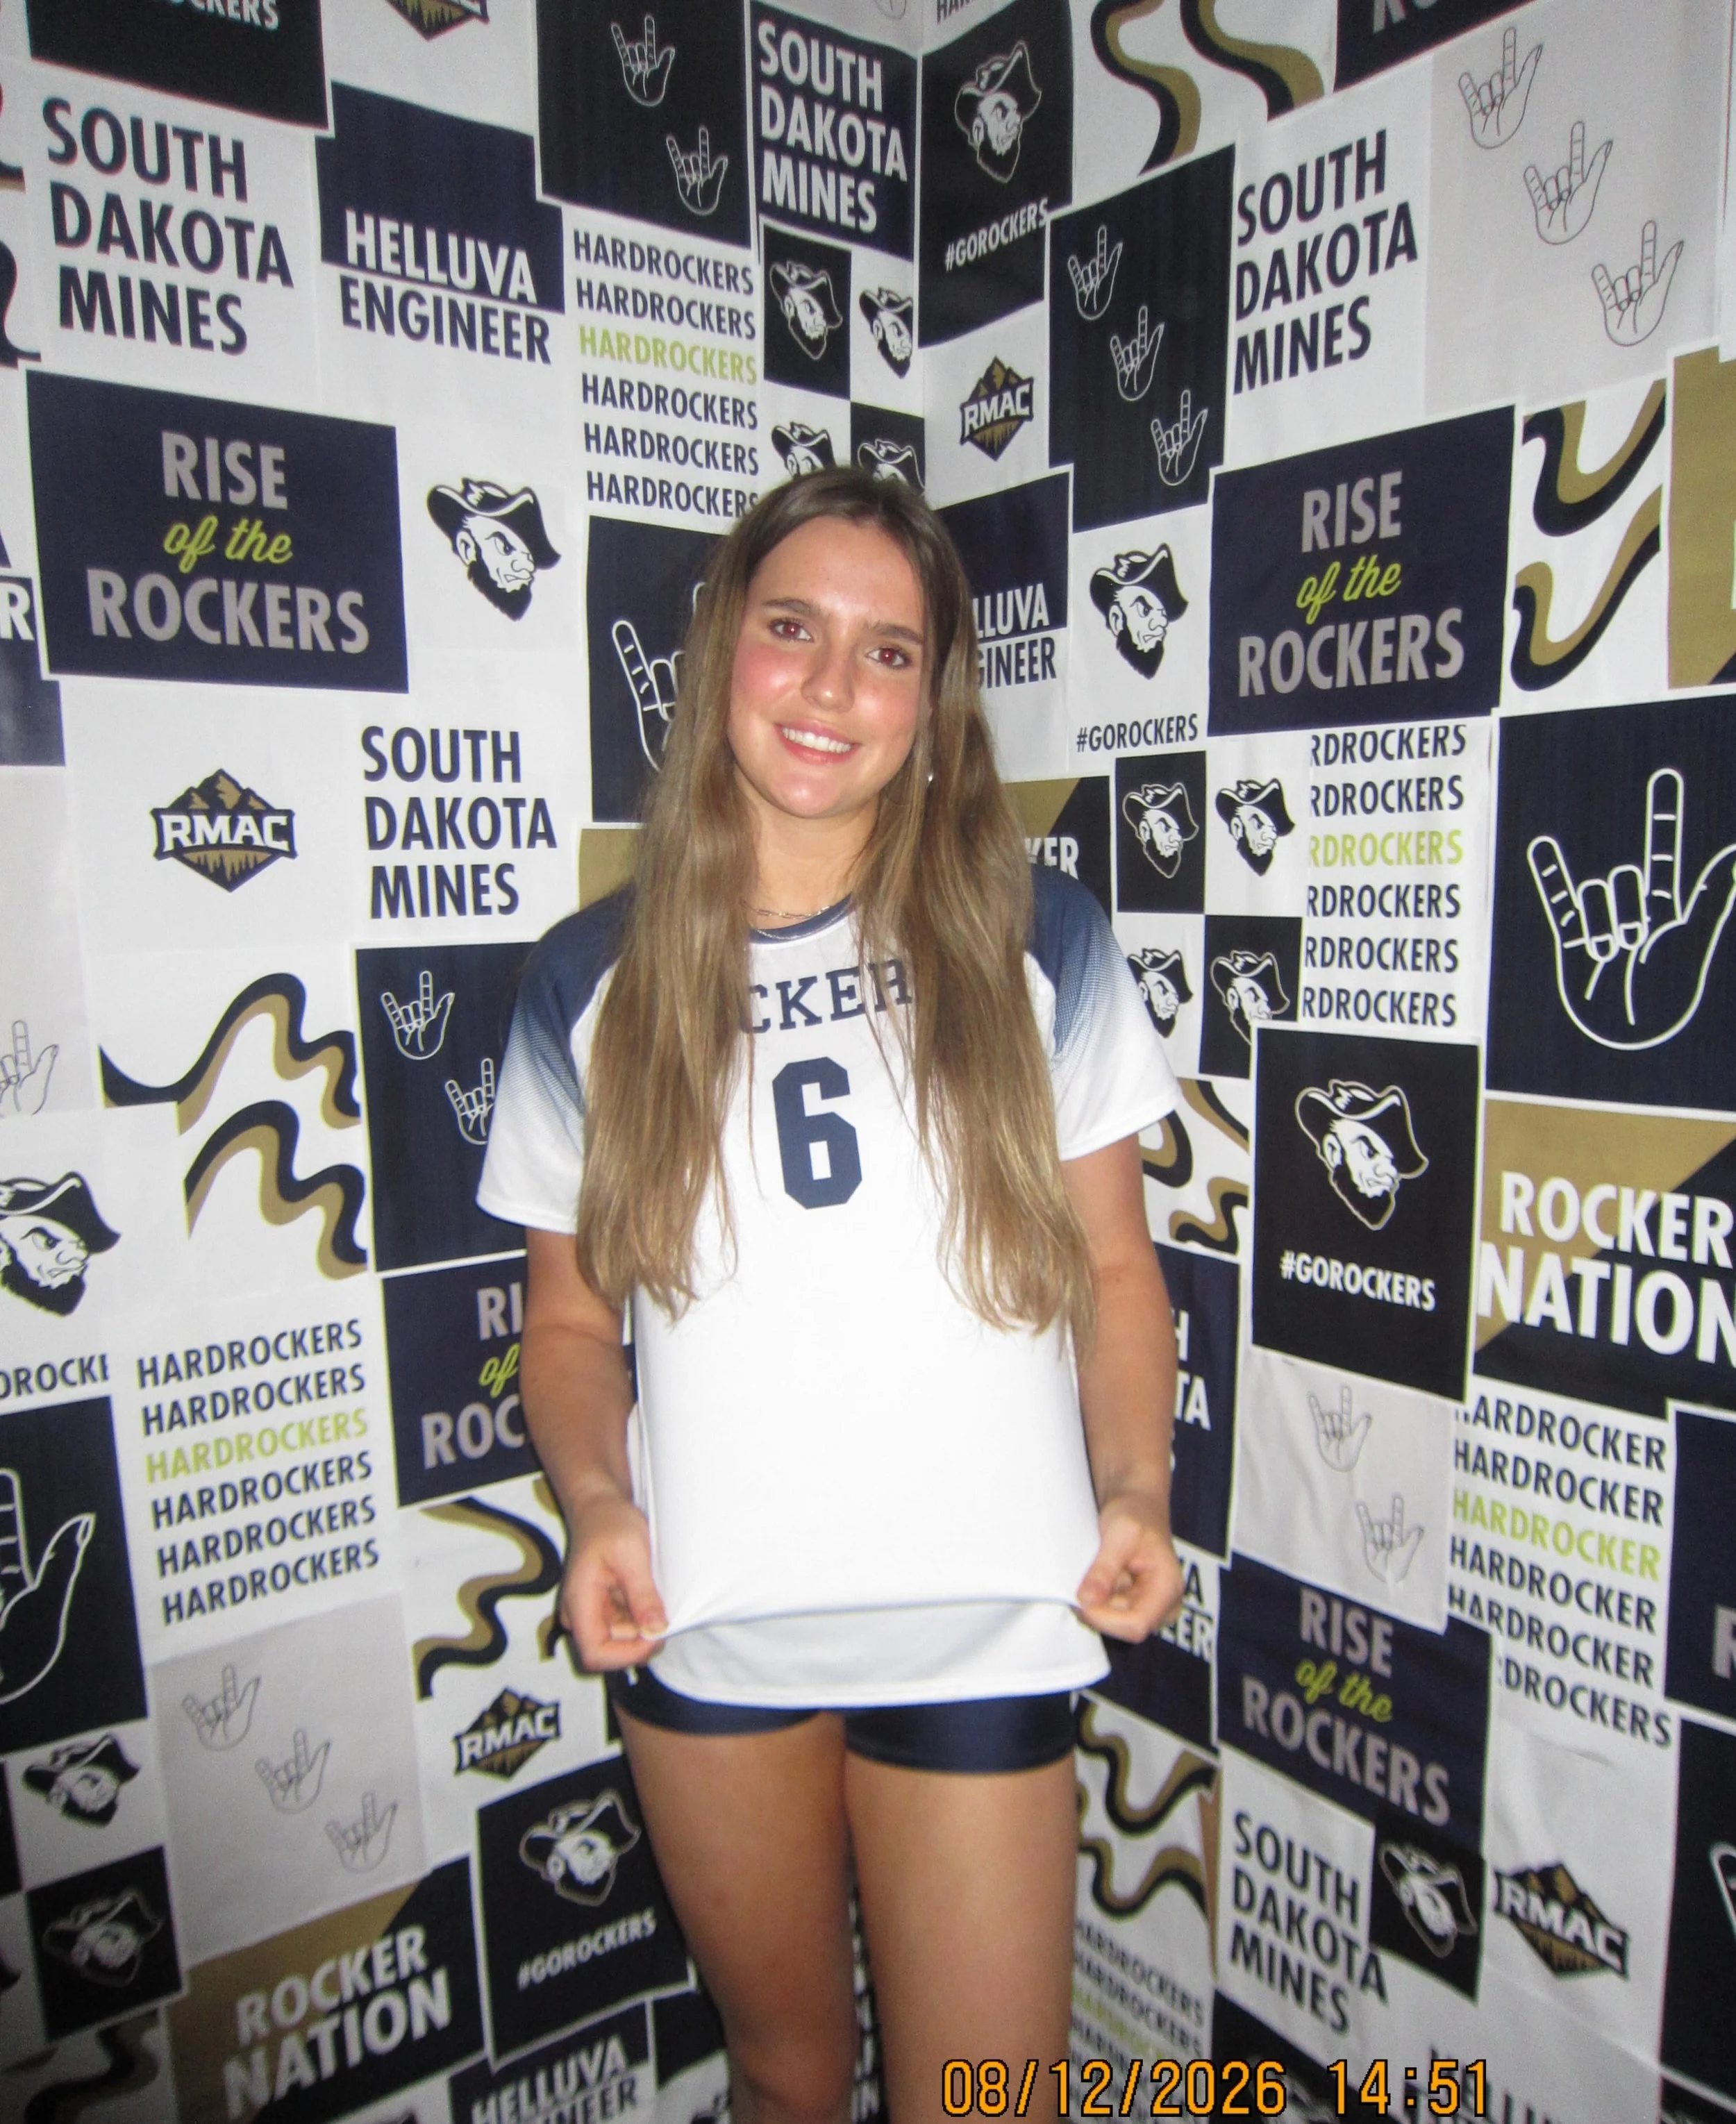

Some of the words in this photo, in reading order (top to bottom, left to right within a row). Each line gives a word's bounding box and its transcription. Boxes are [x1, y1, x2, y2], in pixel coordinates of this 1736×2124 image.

[758, 20, 883, 112] SOUTH
[42, 97, 248, 203] SOUTH
[761, 85, 907, 182] DAKOTA
[763, 149, 877, 233] MINES
[1238, 128, 1387, 248] SOUTH
[50, 181, 294, 288] DAKOTA
[346, 208, 537, 304] HELLUVA
[574, 228, 754, 295] HARDROCKERS
[945, 198, 1048, 271] #GOROCKERS
[1235, 201, 1418, 321] DAKOTA
[58, 265, 248, 356] MINES
[340, 275, 551, 365] ENGINEER
[576, 277, 756, 340] HARDROCKERS
[1233, 295, 1371, 395] MINES
[578, 324, 757, 385] HARDROCKERS
[582, 373, 758, 430] HARDROCKERS
[965, 383, 1030, 437] RMAC
[161, 430, 287, 510] RISE
[584, 422, 759, 476] HARDROCKERS
[164, 515, 215, 574] of
[226, 519, 293, 563] the
[1301, 470, 1402, 553] RISE
[87, 568, 369, 655] ROCKERS
[1297, 561, 1340, 625] of
[1344, 554, 1402, 597] the
[1238, 608, 1464, 698] ROCKERS
[361, 726, 521, 784] SOUTH
[1077, 713, 1198, 753] #GOROCKERS
[161, 814, 290, 849] RMAC
[365, 796, 557, 851] DAKOTA
[370, 863, 519, 919] MINES
[772, 1057, 862, 1210] 6
[1501, 1170, 1734, 1269] ROCKER
[1280, 1251, 1435, 1312] #GOROCKERS
[1478, 1241, 1736, 1369] NATION
[137, 1319, 362, 1390] HARDROCKERS
[478, 1343, 520, 1398] of
[142, 1363, 366, 1437] HARDROCKERS
[145, 1407, 368, 1484] HARDROCKERS
[1455, 1438, 1664, 1527] HARDROCKER
[151, 1450, 372, 1530] HARDROCKERS
[157, 1496, 376, 1579] HARDROCKERS
[1453, 1488, 1662, 1582] HARDROCKER
[161, 1539, 379, 1626] HARDROCKERS
[1451, 1533, 1656, 1635] HARDROCKER
[1299, 1586, 1394, 1679] RISE
[1449, 1582, 1653, 1689] HARDROCKER
[1295, 1659, 1337, 1704] of
[1339, 1670, 1392, 1723] the
[1497, 1656, 1673, 1750] DROCKERS
[460, 1705, 556, 1769] RMAC
[1242, 1673, 1449, 1827] ROCKERS
[1235, 1811, 1359, 1929] SOUTH
[517, 1907, 657, 1991] #GOROCKERS
[1233, 1866, 1387, 2008] DAKOTA
[1505, 1883, 1623, 1967] RMAC
[237, 1925, 427, 2047] ROCKER
[1230, 1922, 1349, 2038] MINES
[224, 1966, 451, 2120] NATION
[471, 2034, 626, 2124] HELLUVA
